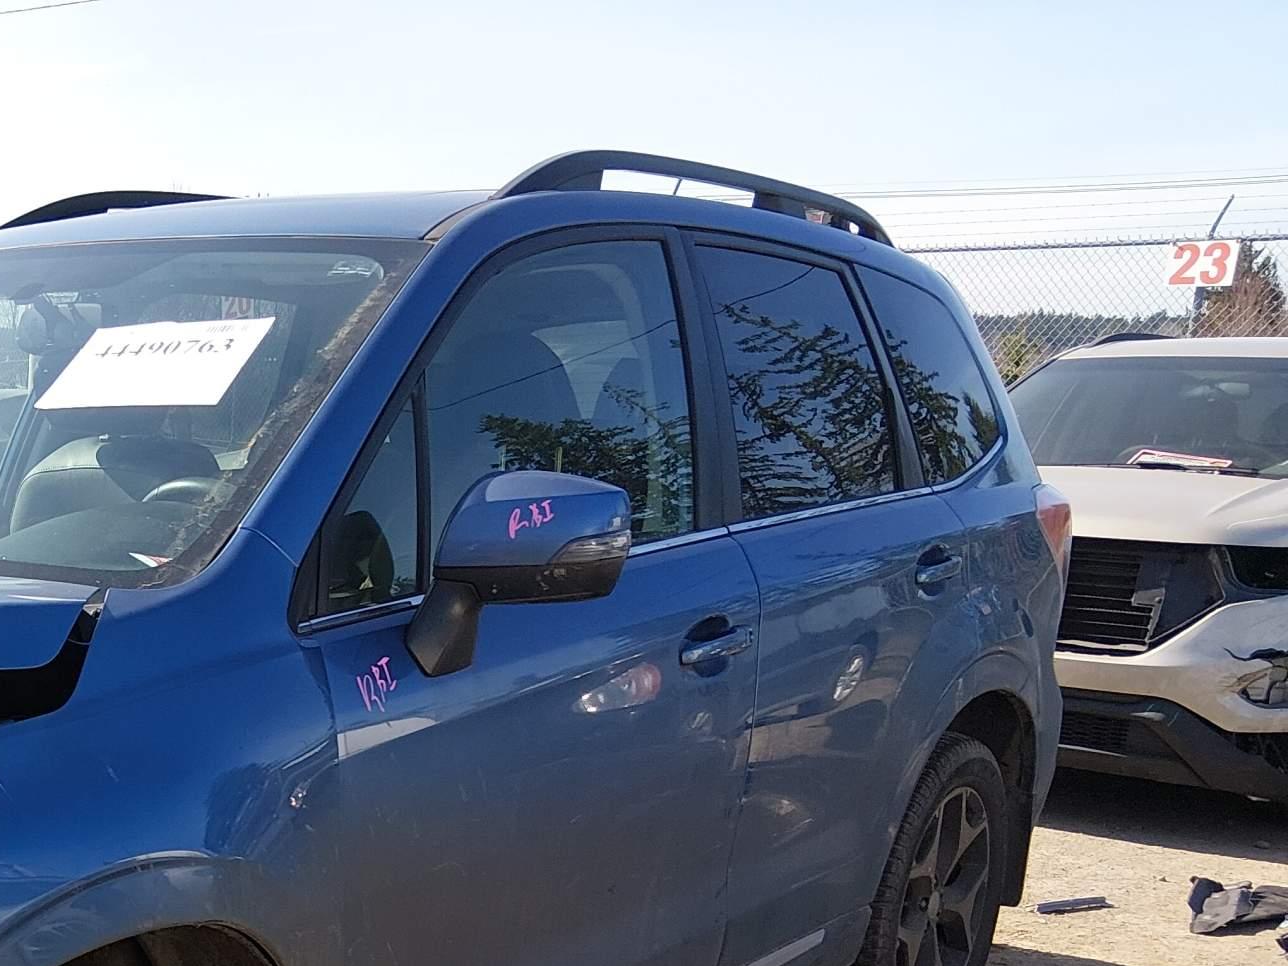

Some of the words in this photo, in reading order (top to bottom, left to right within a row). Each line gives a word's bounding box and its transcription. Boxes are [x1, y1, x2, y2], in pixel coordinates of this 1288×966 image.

[1168, 242, 1231, 285] 23
[224, 298, 249, 318] 20
[96, 338, 235, 358] 44490763
